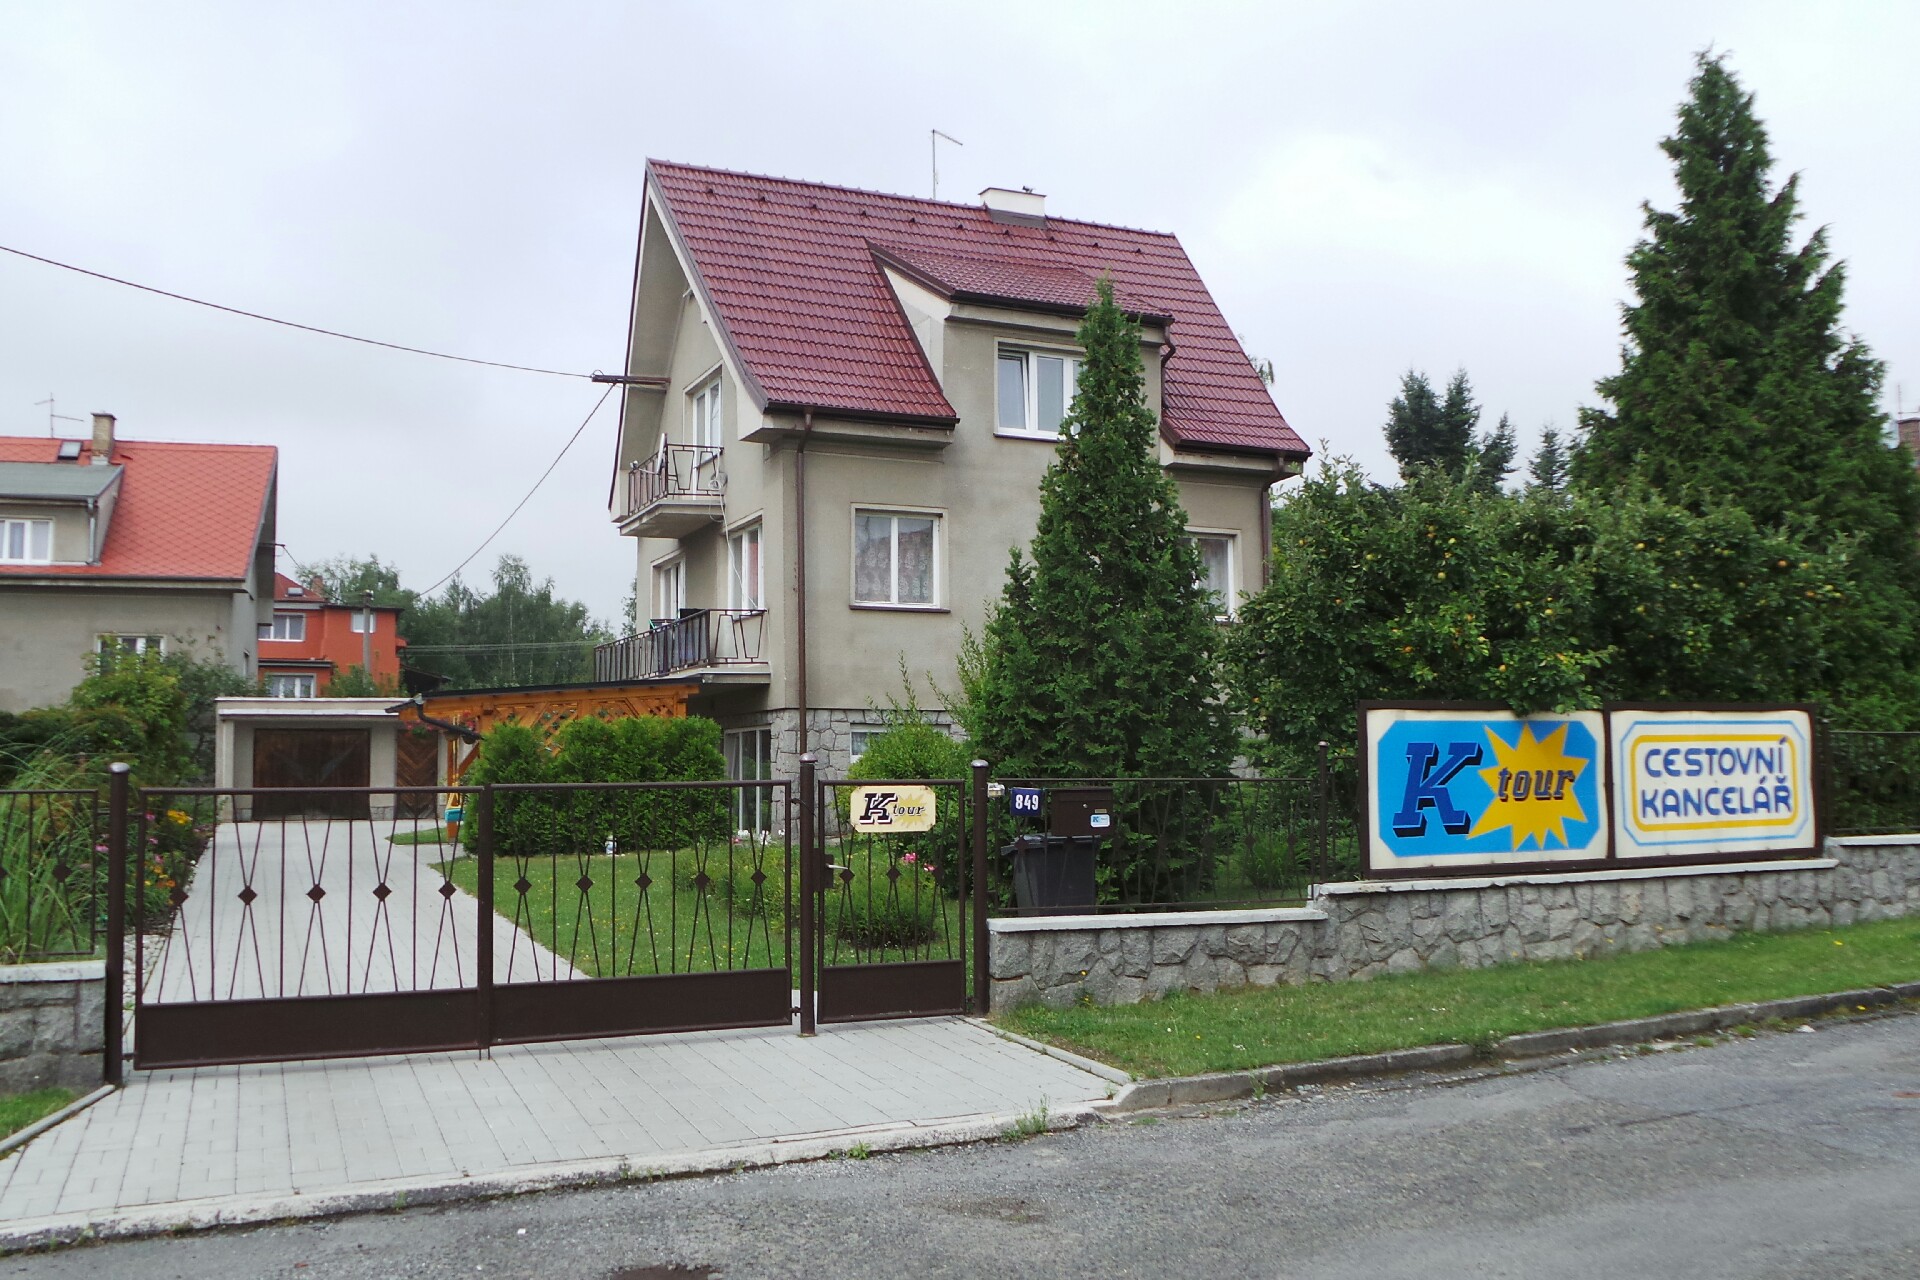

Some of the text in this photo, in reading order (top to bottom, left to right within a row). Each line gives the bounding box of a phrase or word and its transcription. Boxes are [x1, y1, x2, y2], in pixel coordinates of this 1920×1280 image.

[1644, 737, 1787, 777] CESTOVNÍ
[859, 792, 925, 825] K tour
[1015, 794, 1039, 810] 849
[1392, 741, 1574, 838] K tour
[1641, 776, 1793, 819] KANCELÁŘ
